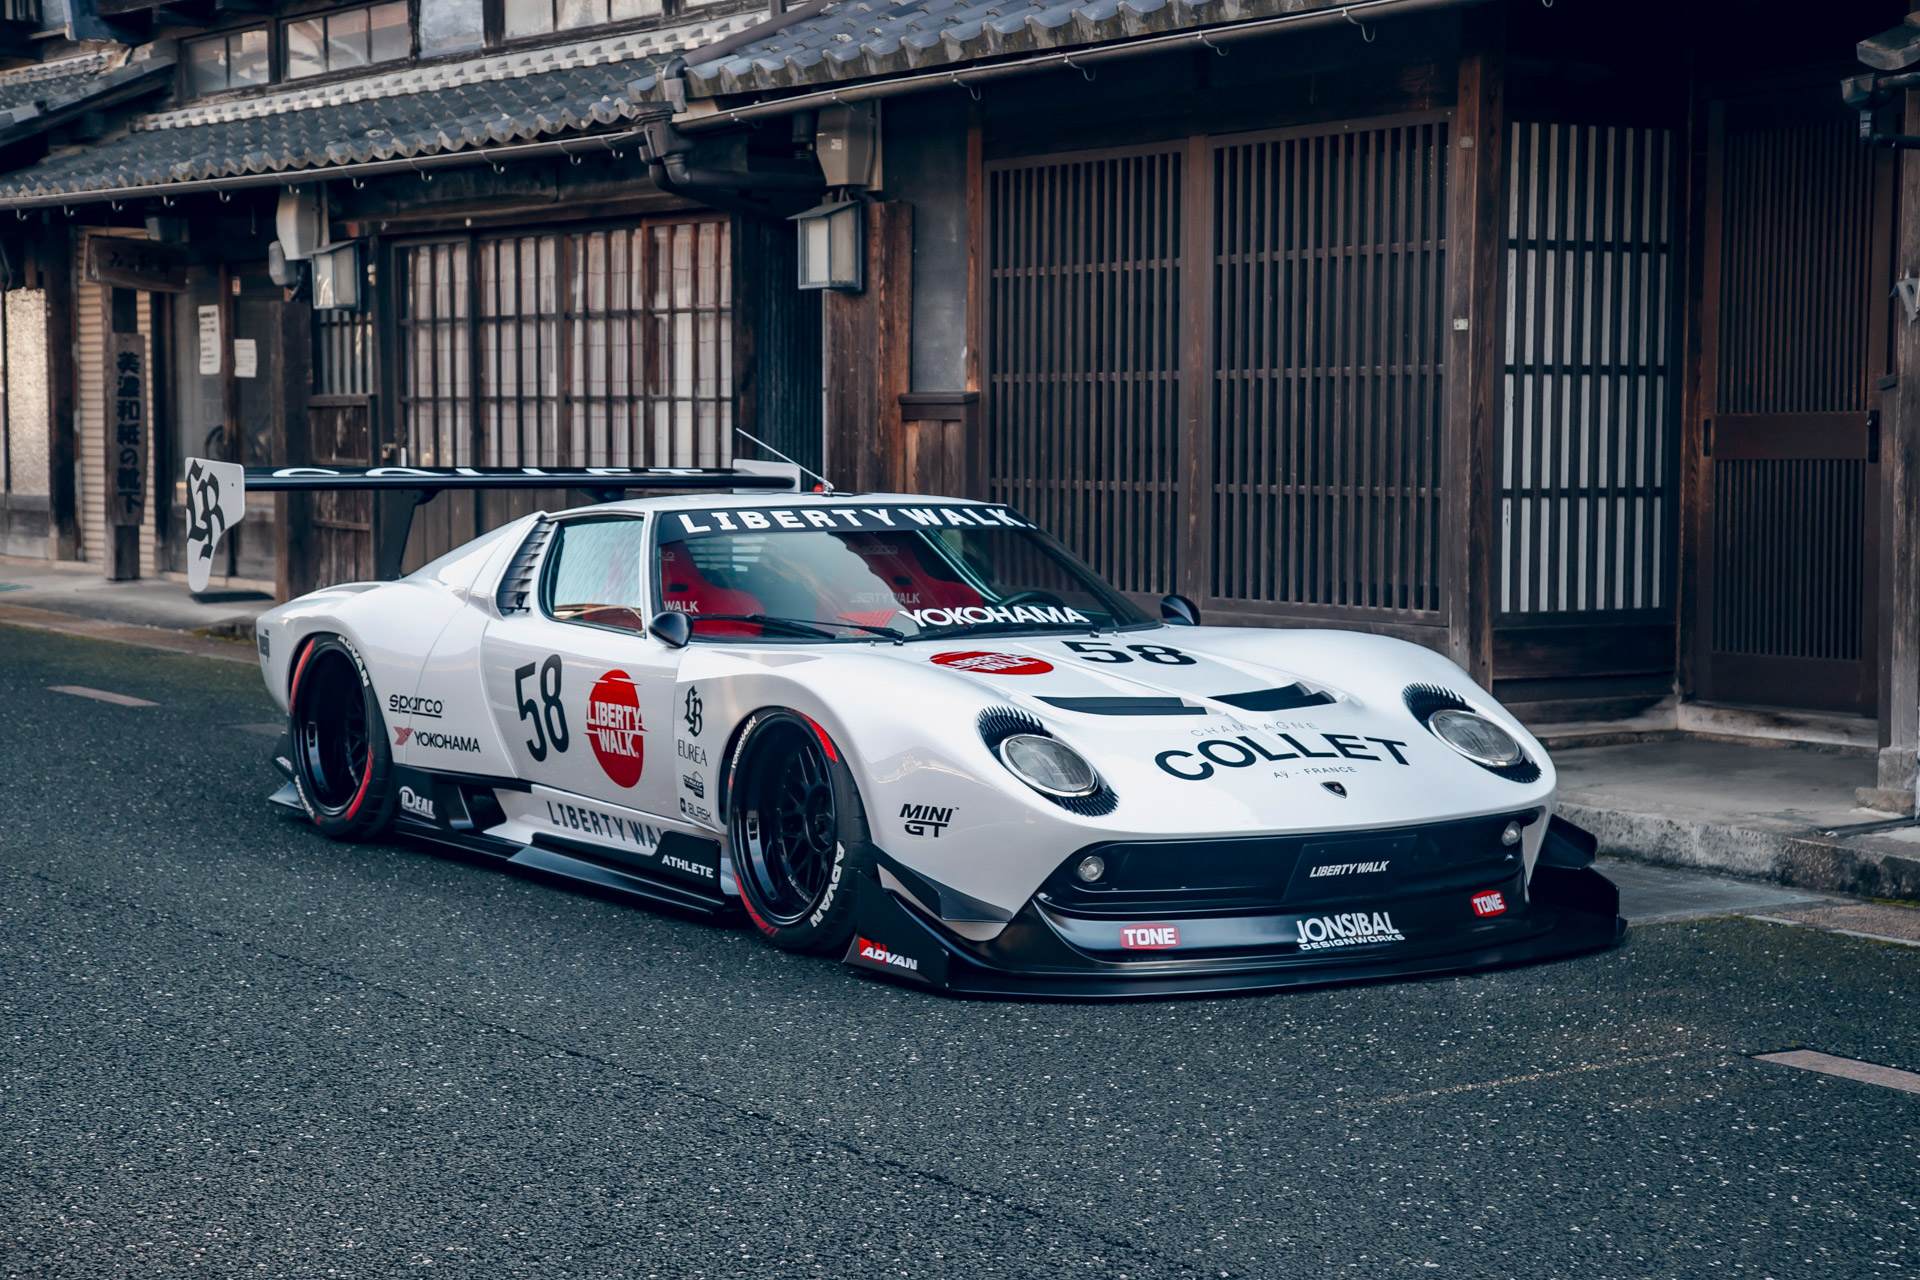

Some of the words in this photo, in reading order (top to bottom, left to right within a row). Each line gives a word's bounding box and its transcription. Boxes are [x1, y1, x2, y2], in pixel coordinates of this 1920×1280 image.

[678, 509, 896, 533] LIBERTY
[664, 600, 699, 613] WALK
[899, 606, 1090, 627] YOKOHAMA
[1061, 641, 1198, 665] 58
[389, 694, 443, 716] sparco
[515, 654, 569, 762] 58
[587, 700, 643, 733] LIBERTY
[414, 730, 481, 753] YOKOHAMA
[597, 728, 639, 758] WALK
[678, 739, 708, 767] EUREA
[1155, 733, 1410, 780] COLLET
[1303, 766, 1357, 775] FRANCE
[546, 801, 625, 842] LIBERTY
[899, 803, 954, 823] MINI
[904, 820, 948, 838] GT
[661, 855, 714, 879] ATHLETE
[1309, 863, 1357, 878] LIBERTY
[1356, 861, 1390, 874] WALK
[809, 841, 845, 928] ADVAN
[1473, 893, 1505, 915] TONE
[1123, 927, 1177, 946] TONE
[1296, 912, 1400, 944] JONSIBAL
[1299, 934, 1406, 951] DESIGNWORKS
[861, 947, 918, 970] ADVAN
